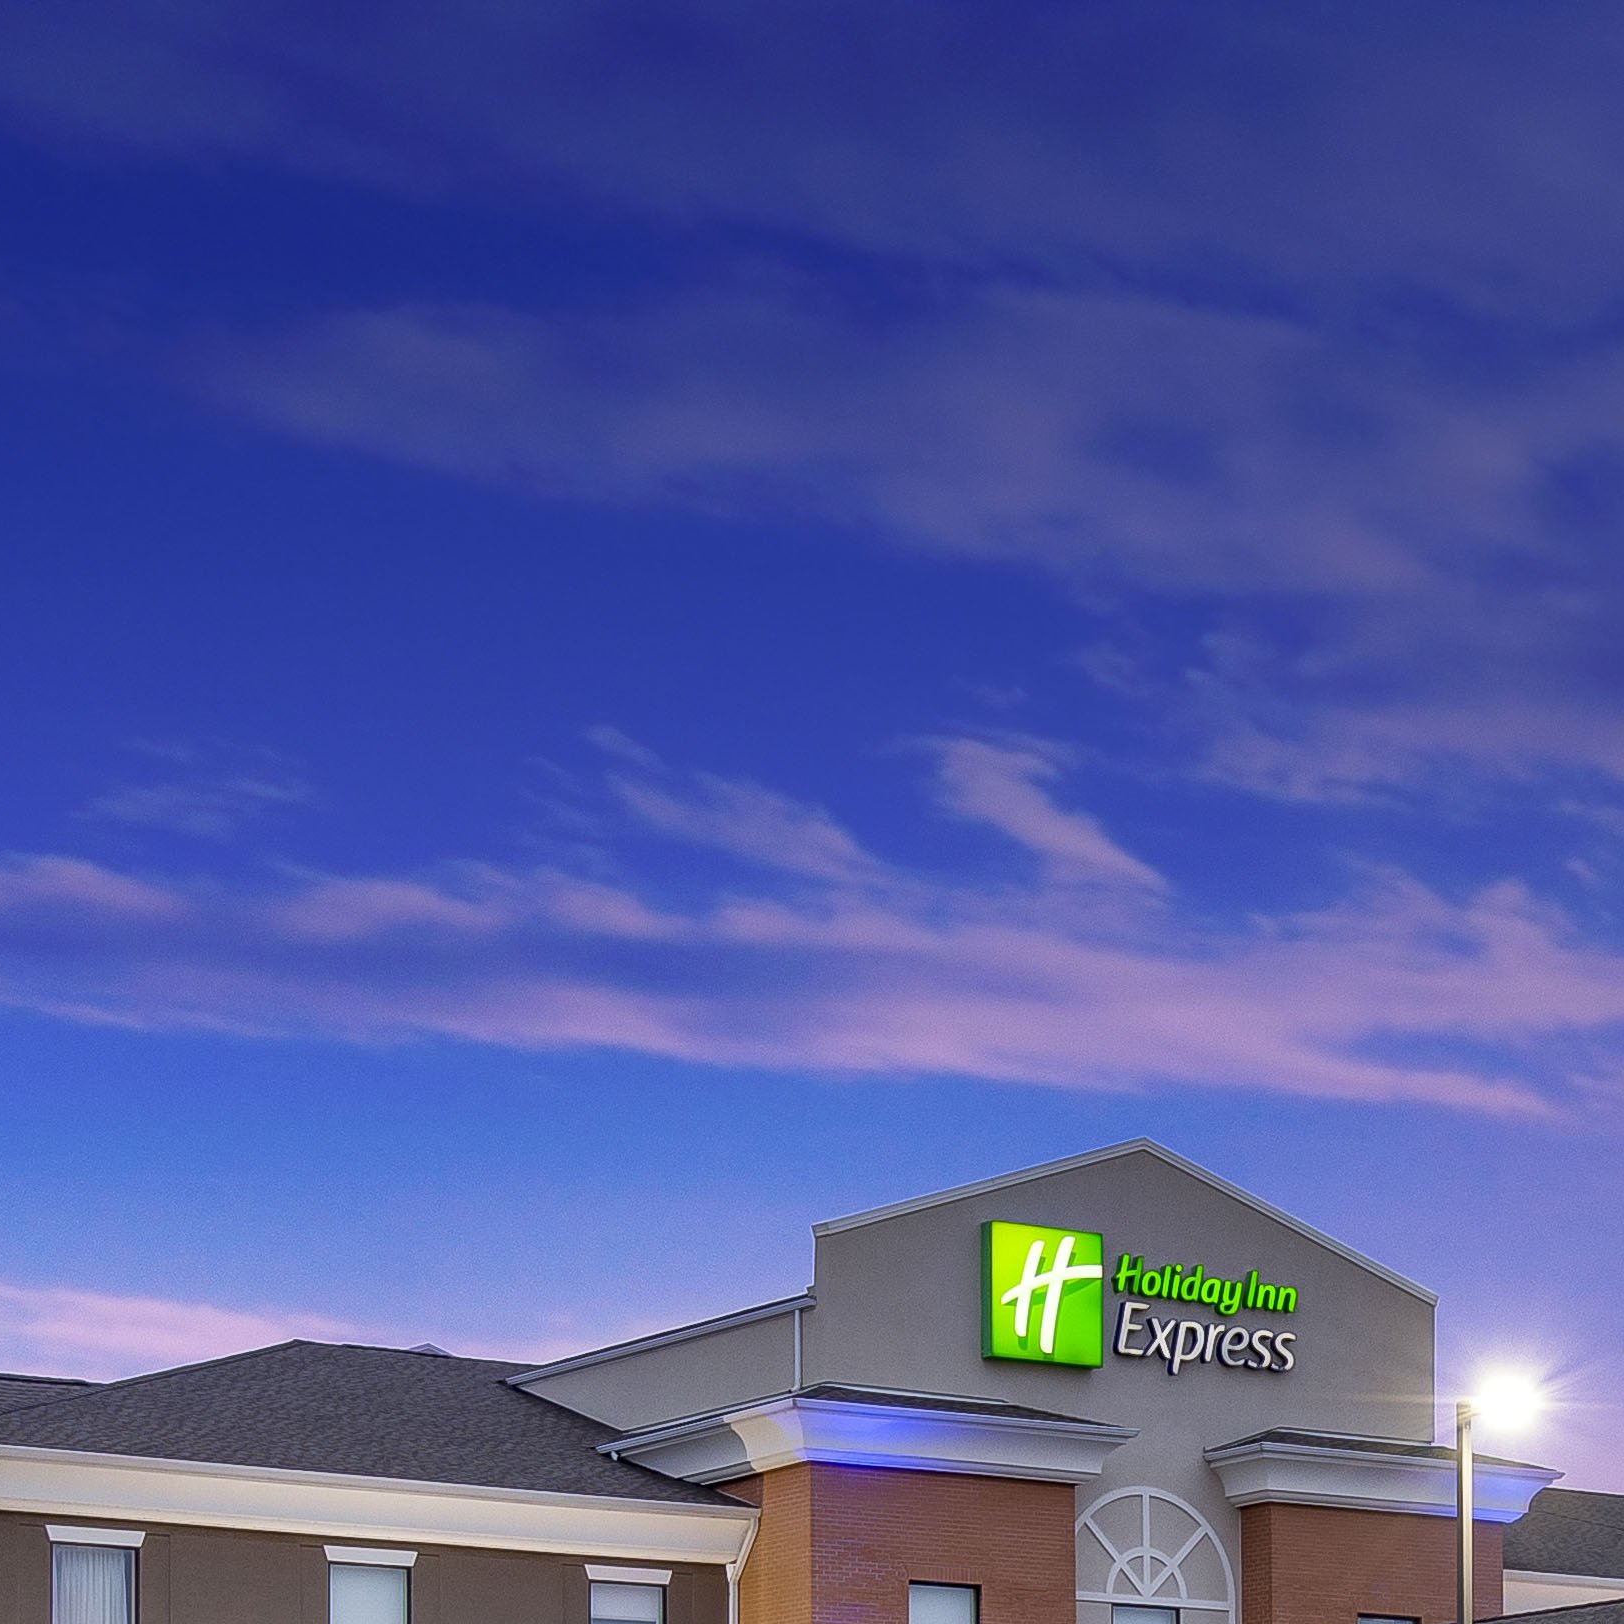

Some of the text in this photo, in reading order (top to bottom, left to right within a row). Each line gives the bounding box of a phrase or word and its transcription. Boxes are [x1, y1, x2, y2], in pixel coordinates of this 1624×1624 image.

[1114, 1252, 1298, 1316] Holiday Inn
[1114, 1300, 1298, 1376] Express
